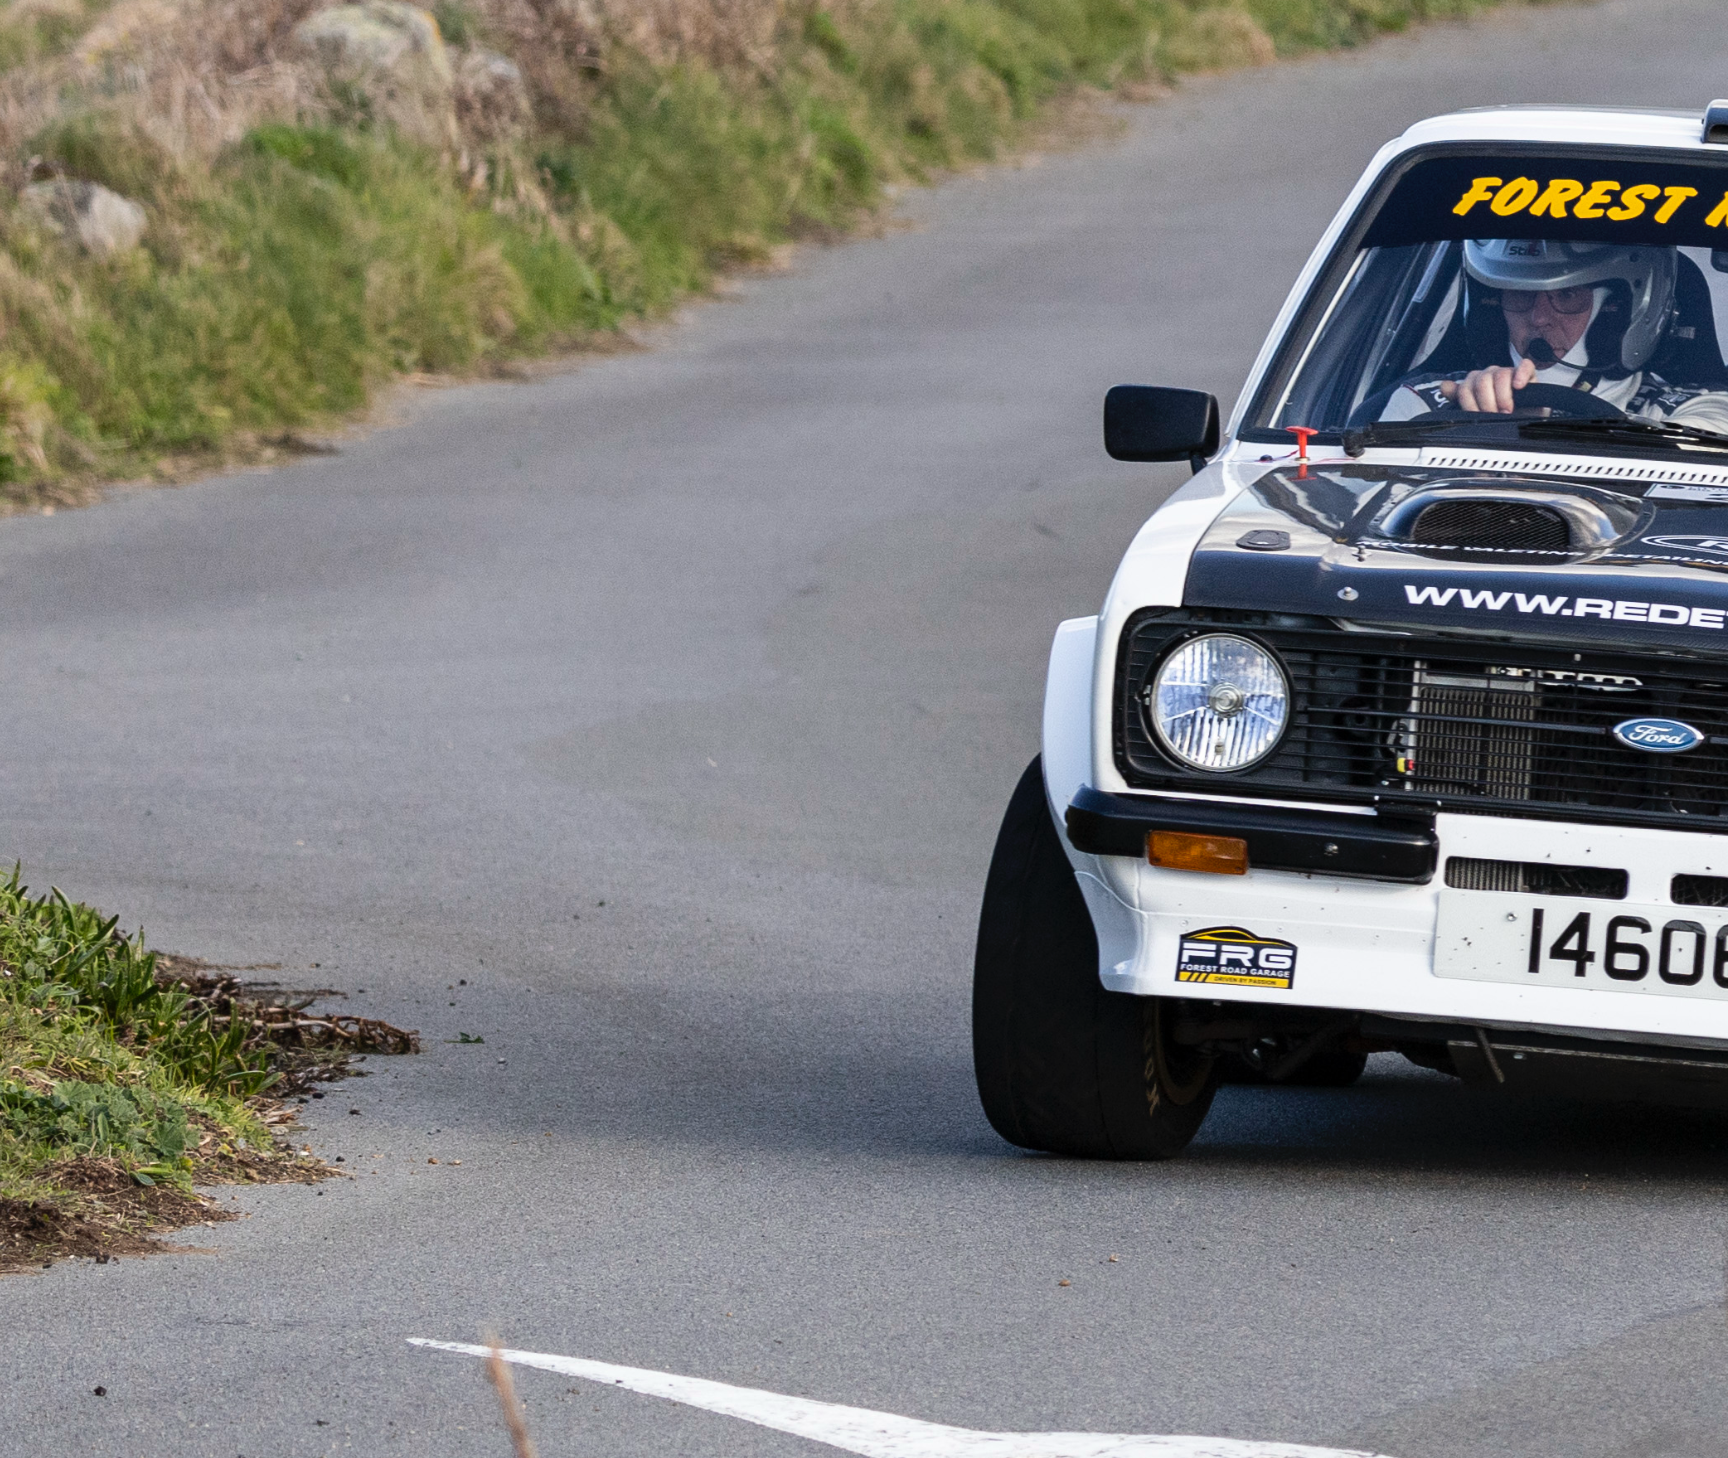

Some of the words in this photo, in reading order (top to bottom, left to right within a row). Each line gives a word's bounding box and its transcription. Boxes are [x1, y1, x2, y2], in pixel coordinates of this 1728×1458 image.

[1452, 176, 1697, 224] FOREST
[1628, 725, 1687, 744] Ford
[1181, 942, 1294, 969] FRG
[1180, 963, 1218, 973] FOREST
[1220, 966, 1247, 975] ROAD
[1250, 969, 1290, 978] GARAGE
